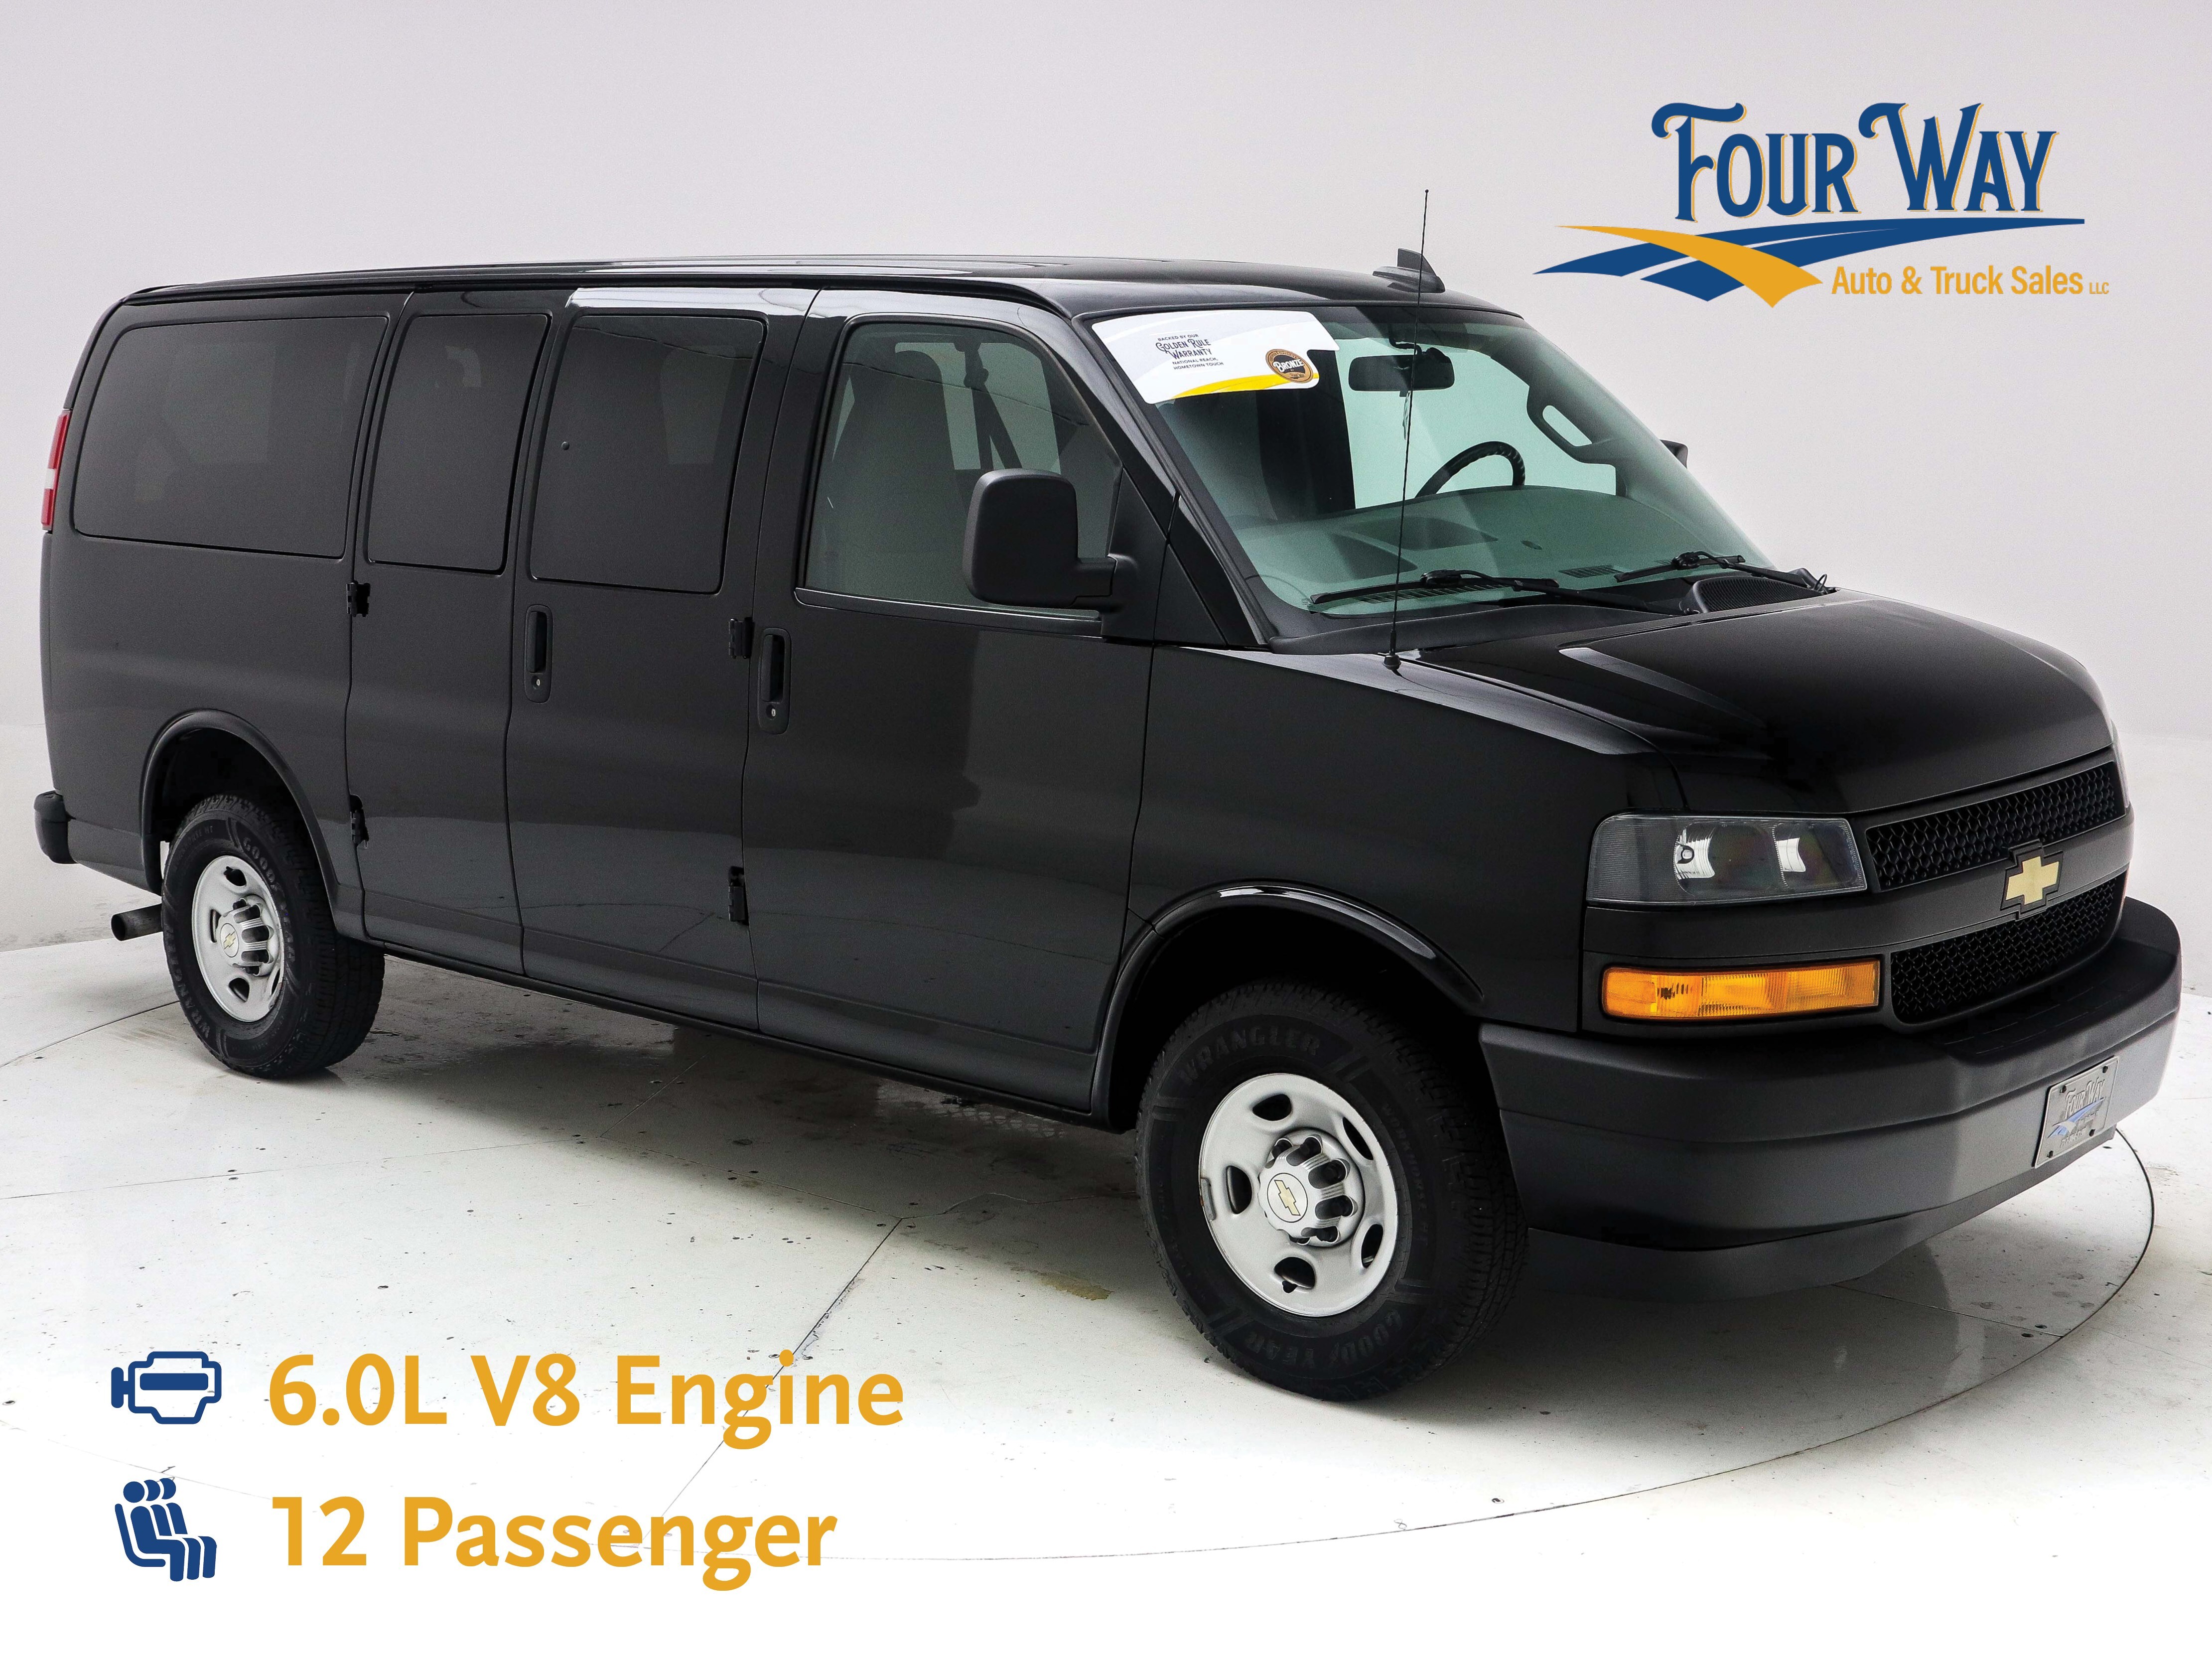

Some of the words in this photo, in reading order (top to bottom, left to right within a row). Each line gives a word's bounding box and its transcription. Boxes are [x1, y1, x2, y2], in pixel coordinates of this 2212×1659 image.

[1156, 341, 1189, 352] GOLDEN
[1187, 339, 1211, 348] RULE
[1165, 349, 1212, 359] WARRANTY
[1273, 359, 1305, 373] BRONZE
[1177, 1025, 1322, 1086] WRANGLER
